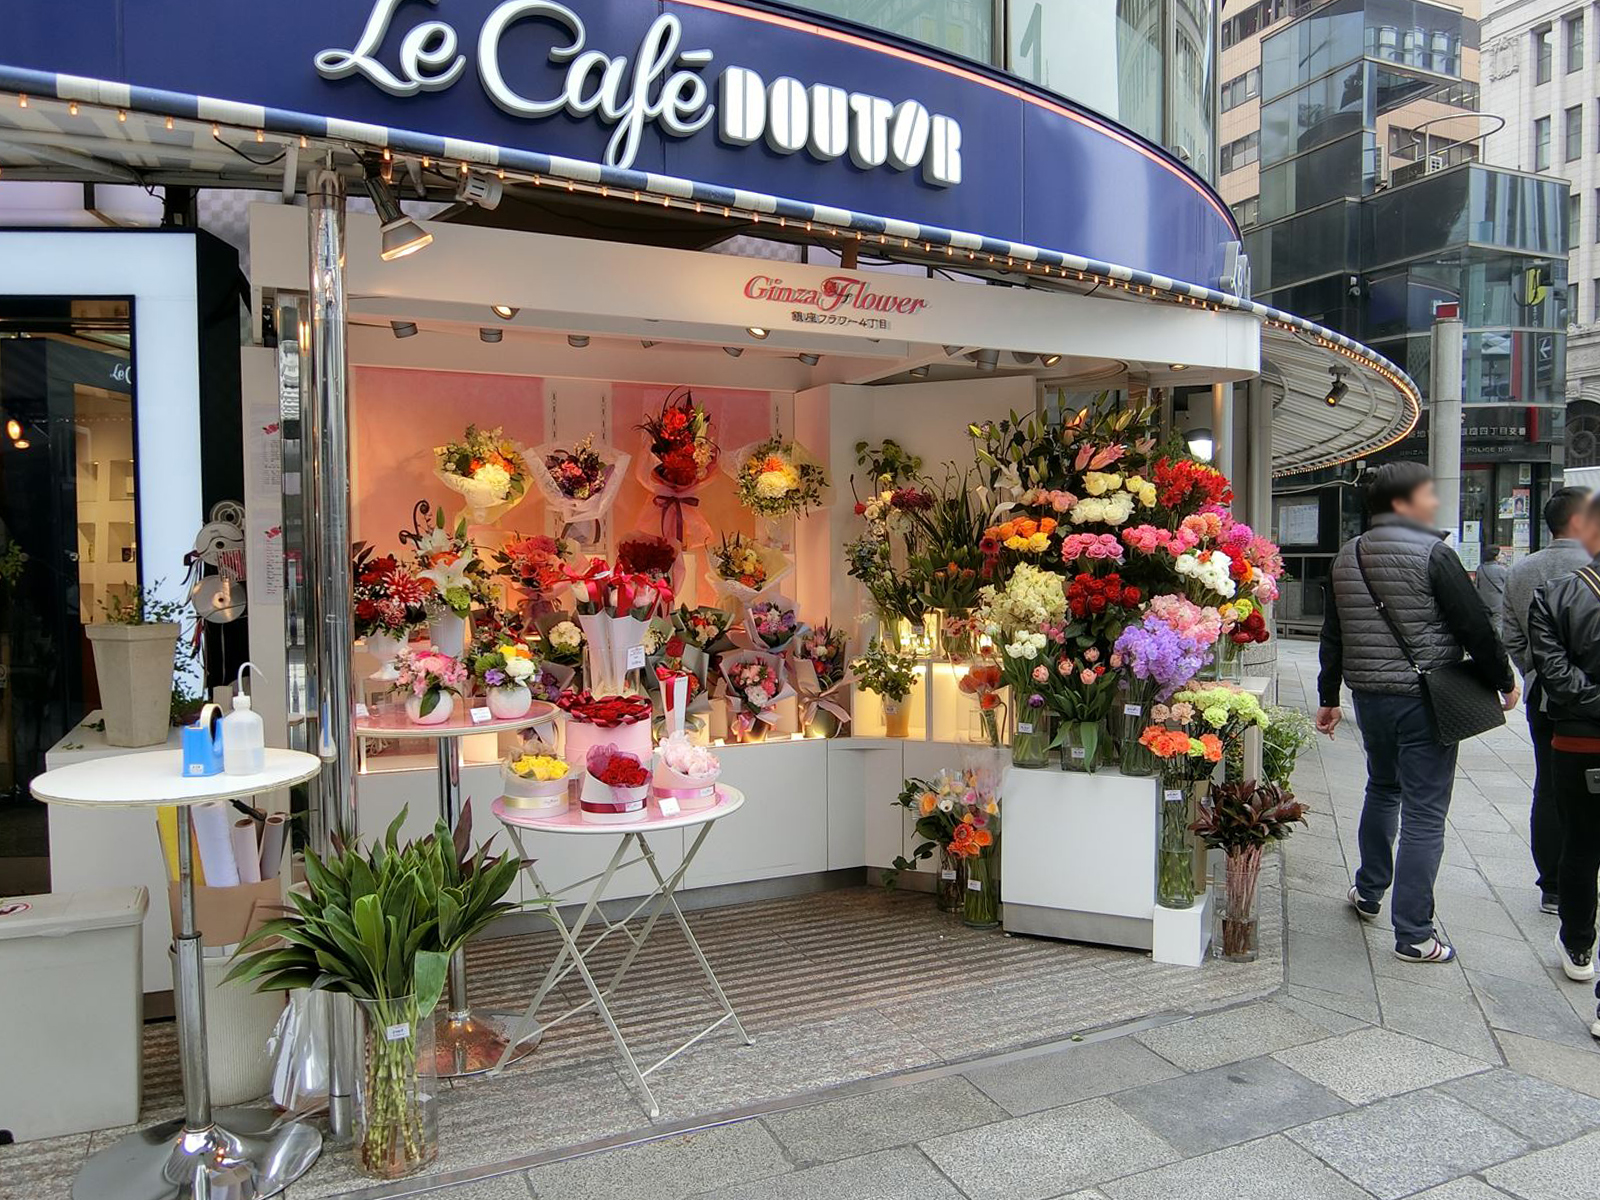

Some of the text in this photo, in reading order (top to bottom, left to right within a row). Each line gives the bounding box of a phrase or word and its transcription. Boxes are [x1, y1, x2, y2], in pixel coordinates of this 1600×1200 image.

[313, 0, 964, 188] Le Café DOUTOR
[743, 274, 927, 315] Ginza Flower
[791, 310, 887, 330] 銀座フラワー4丁目
